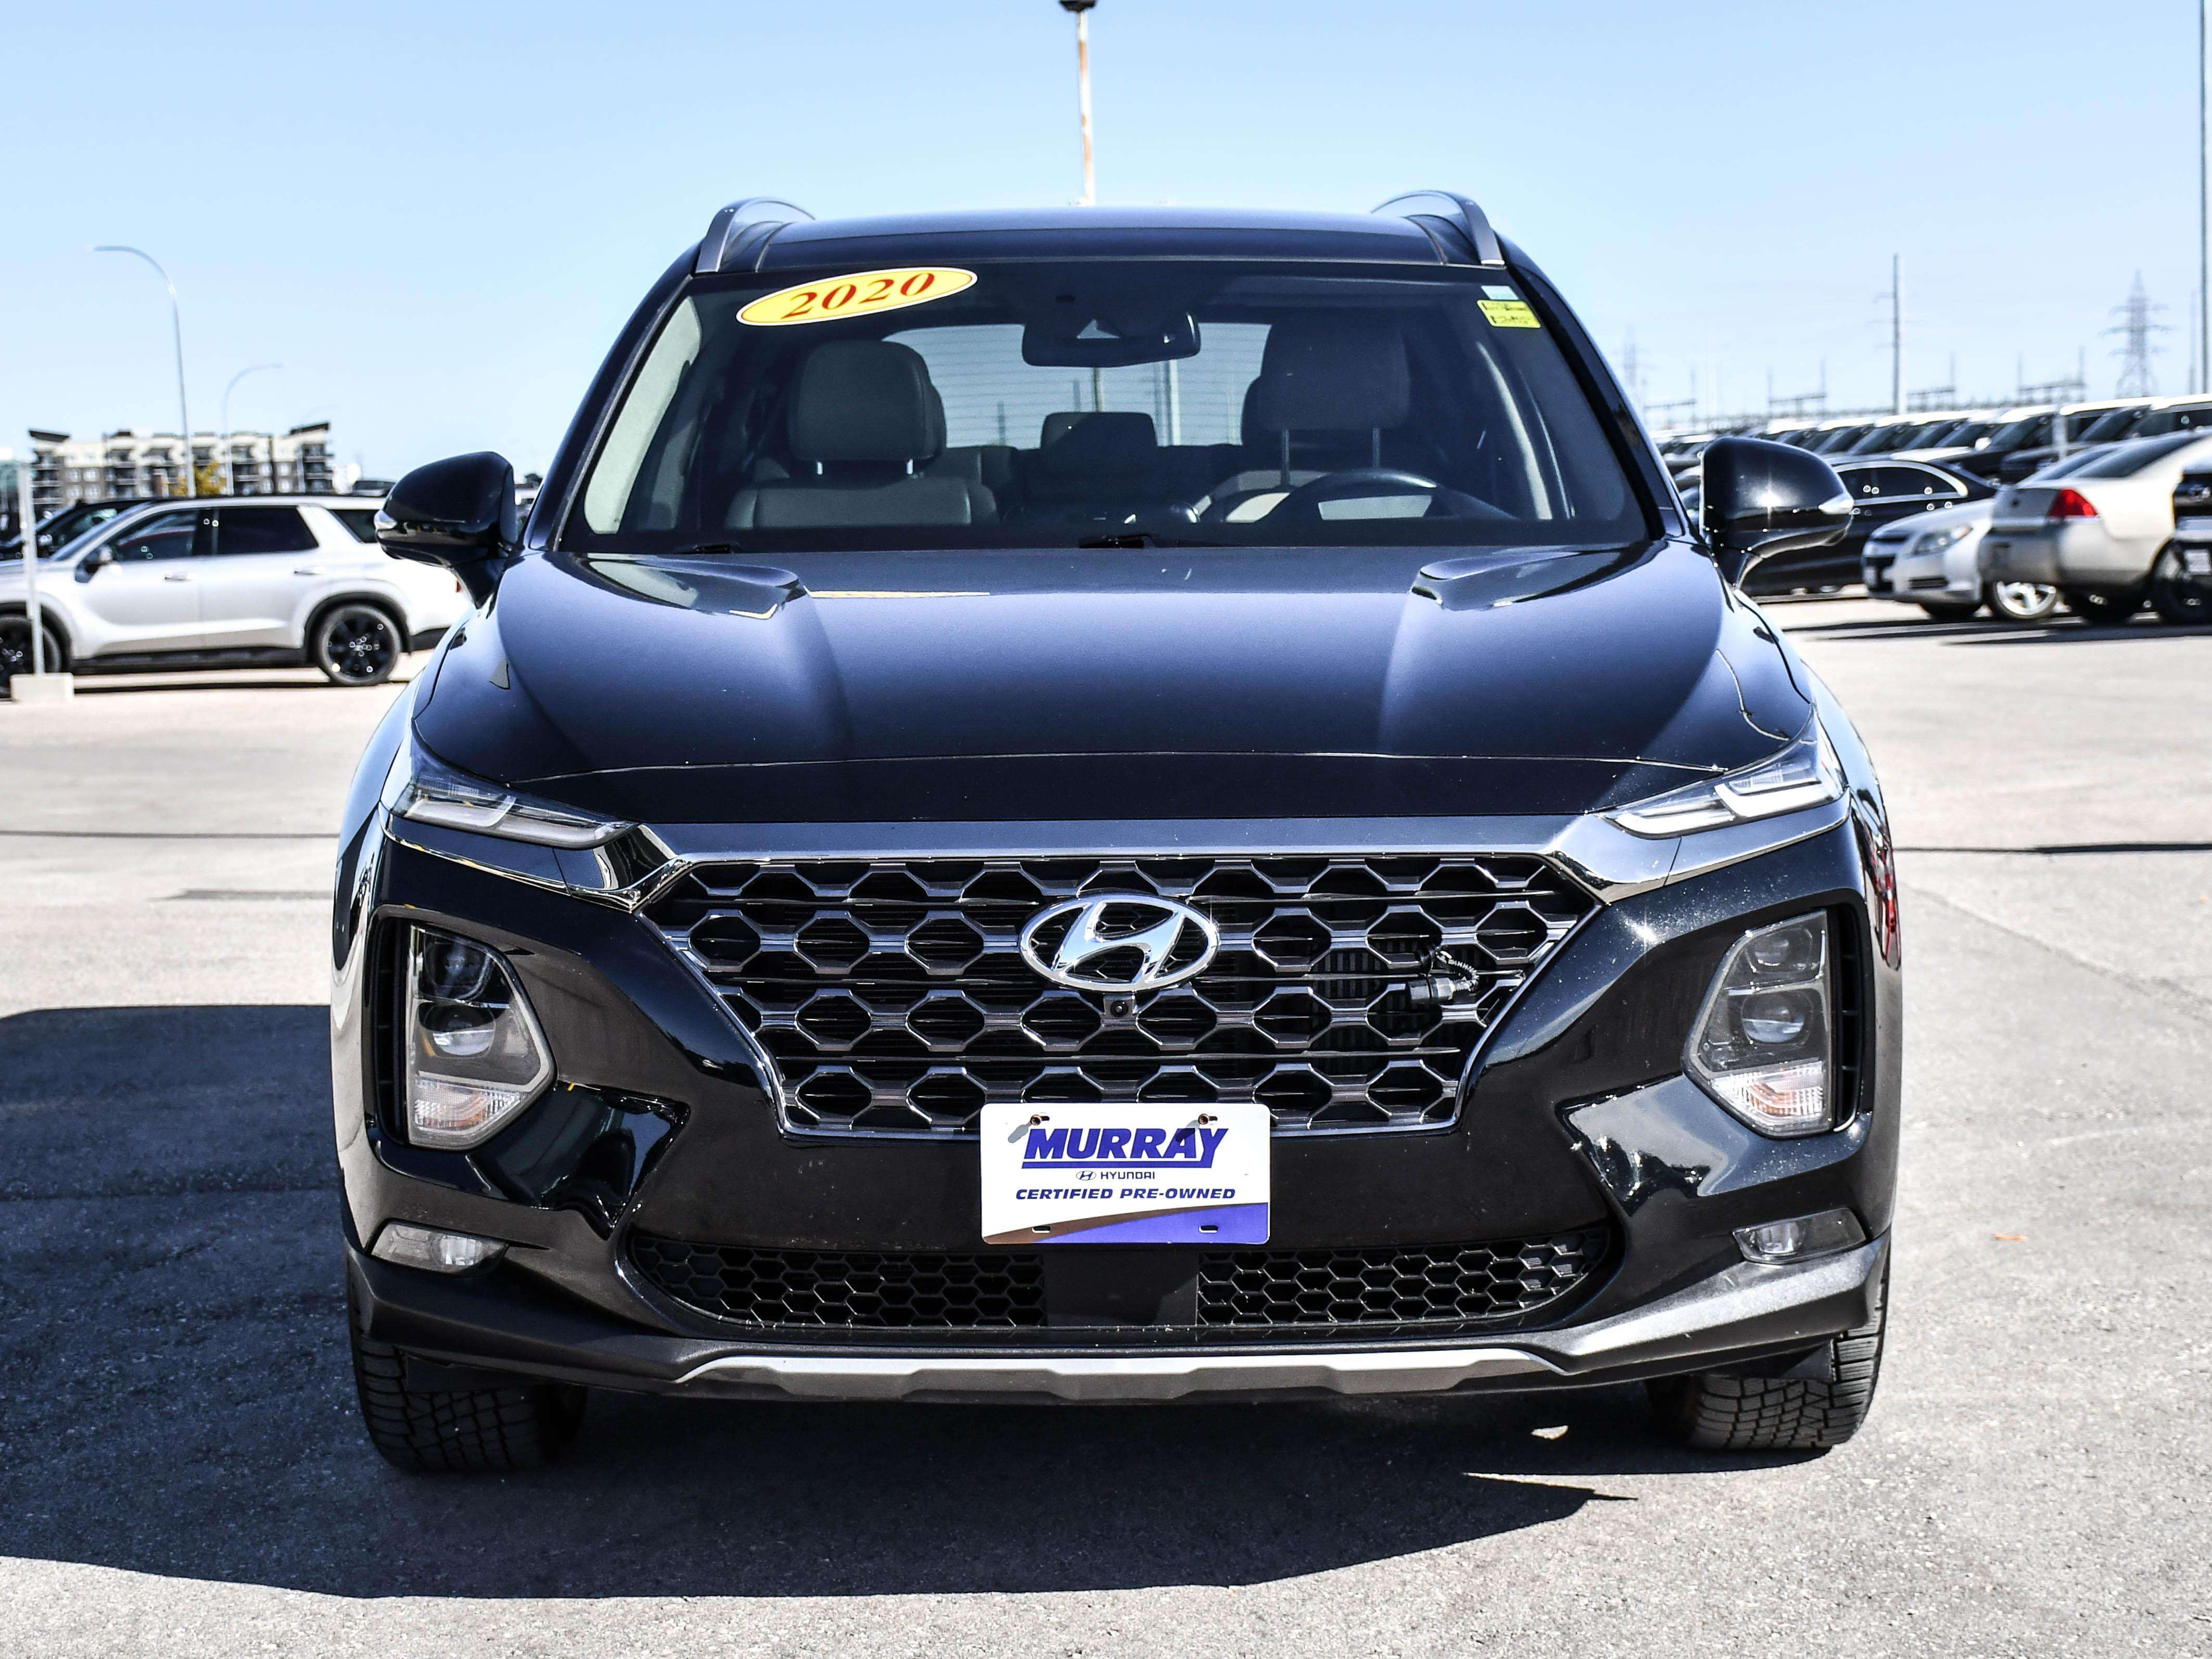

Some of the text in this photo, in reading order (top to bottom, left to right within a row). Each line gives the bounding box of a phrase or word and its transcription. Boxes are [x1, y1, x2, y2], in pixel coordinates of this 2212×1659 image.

[780, 272, 935, 319] 2020
[1022, 1128, 1229, 1168] MURRAY
[1100, 1171, 1155, 1180] HYUNDAI
[1016, 1188, 1236, 1200] CERTIFIED PRE-OWNED
